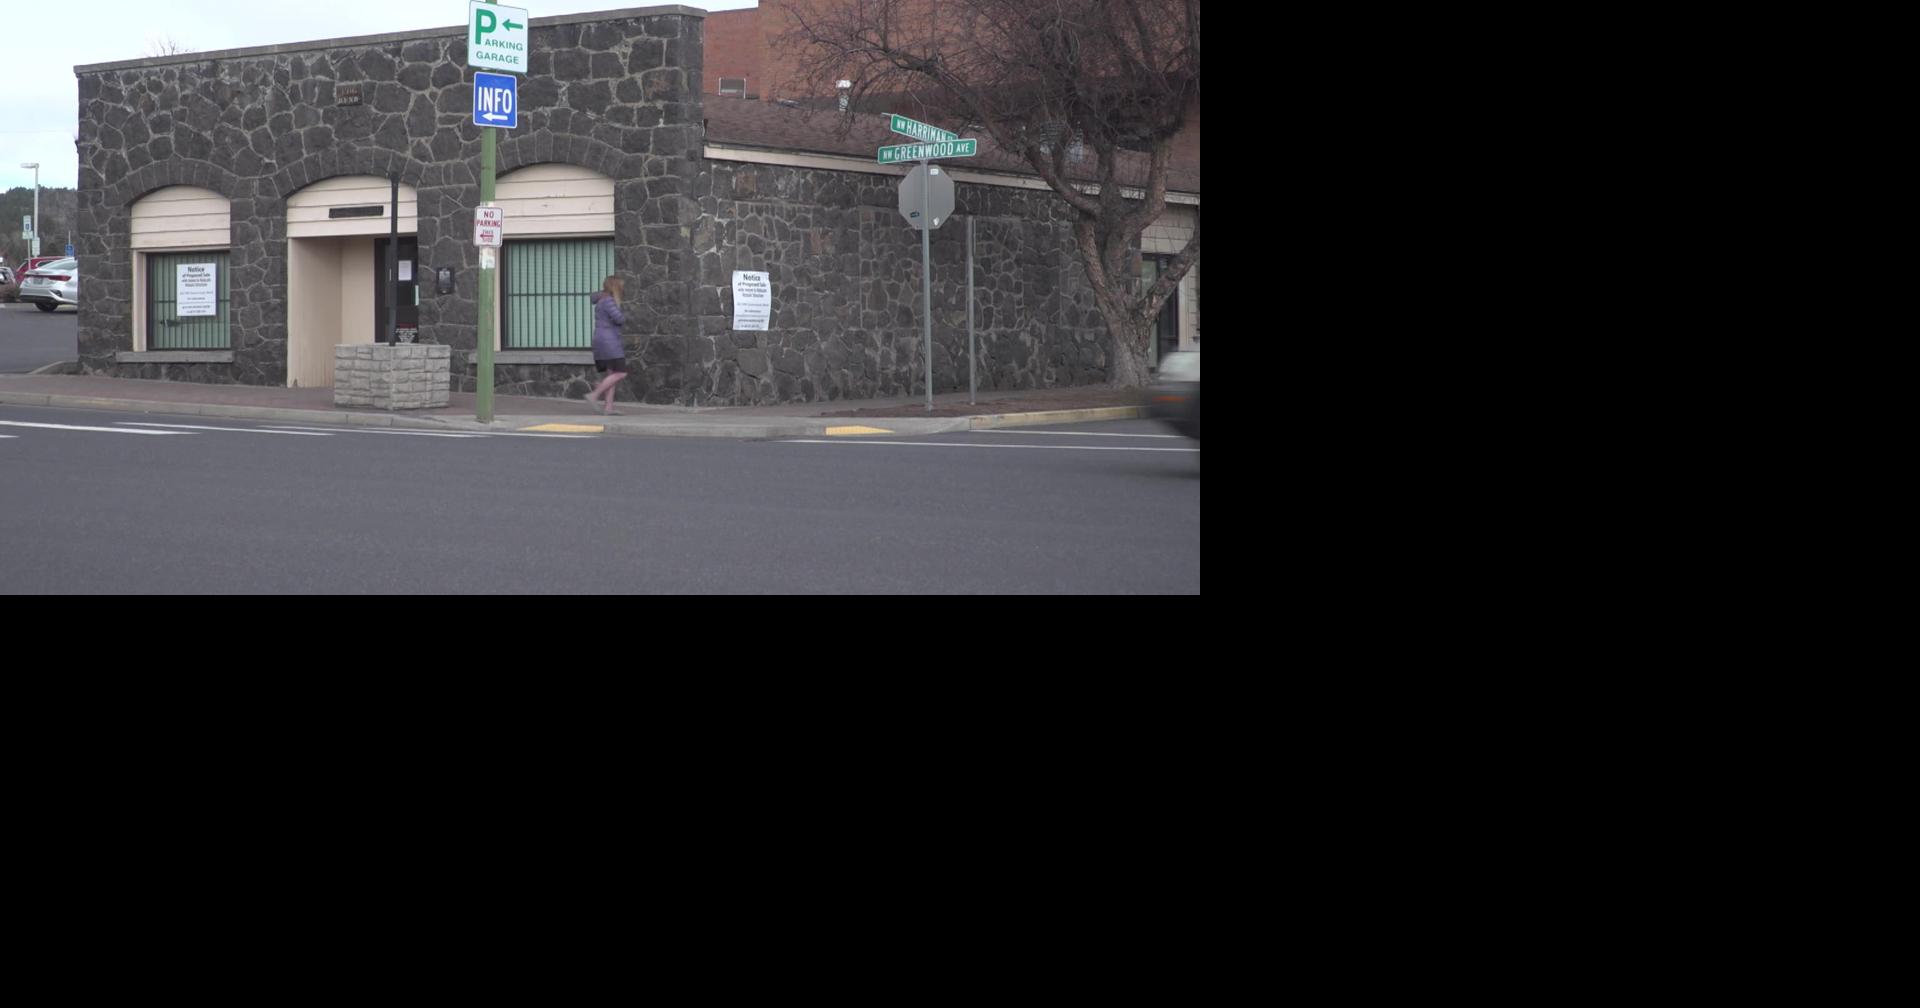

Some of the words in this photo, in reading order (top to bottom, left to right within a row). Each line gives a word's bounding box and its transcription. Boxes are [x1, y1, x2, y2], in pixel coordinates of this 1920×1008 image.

[476, 51, 520, 64] GARAGE
[478, 87, 512, 114] INFO
[896, 119, 906, 130] NW
[906, 120, 946, 141] HARRIMAN
[883, 150, 893, 160] NW
[894, 142, 954, 160] GREENWOOD
[956, 142, 970, 153] AVE
[743, 273, 761, 281] Notice
